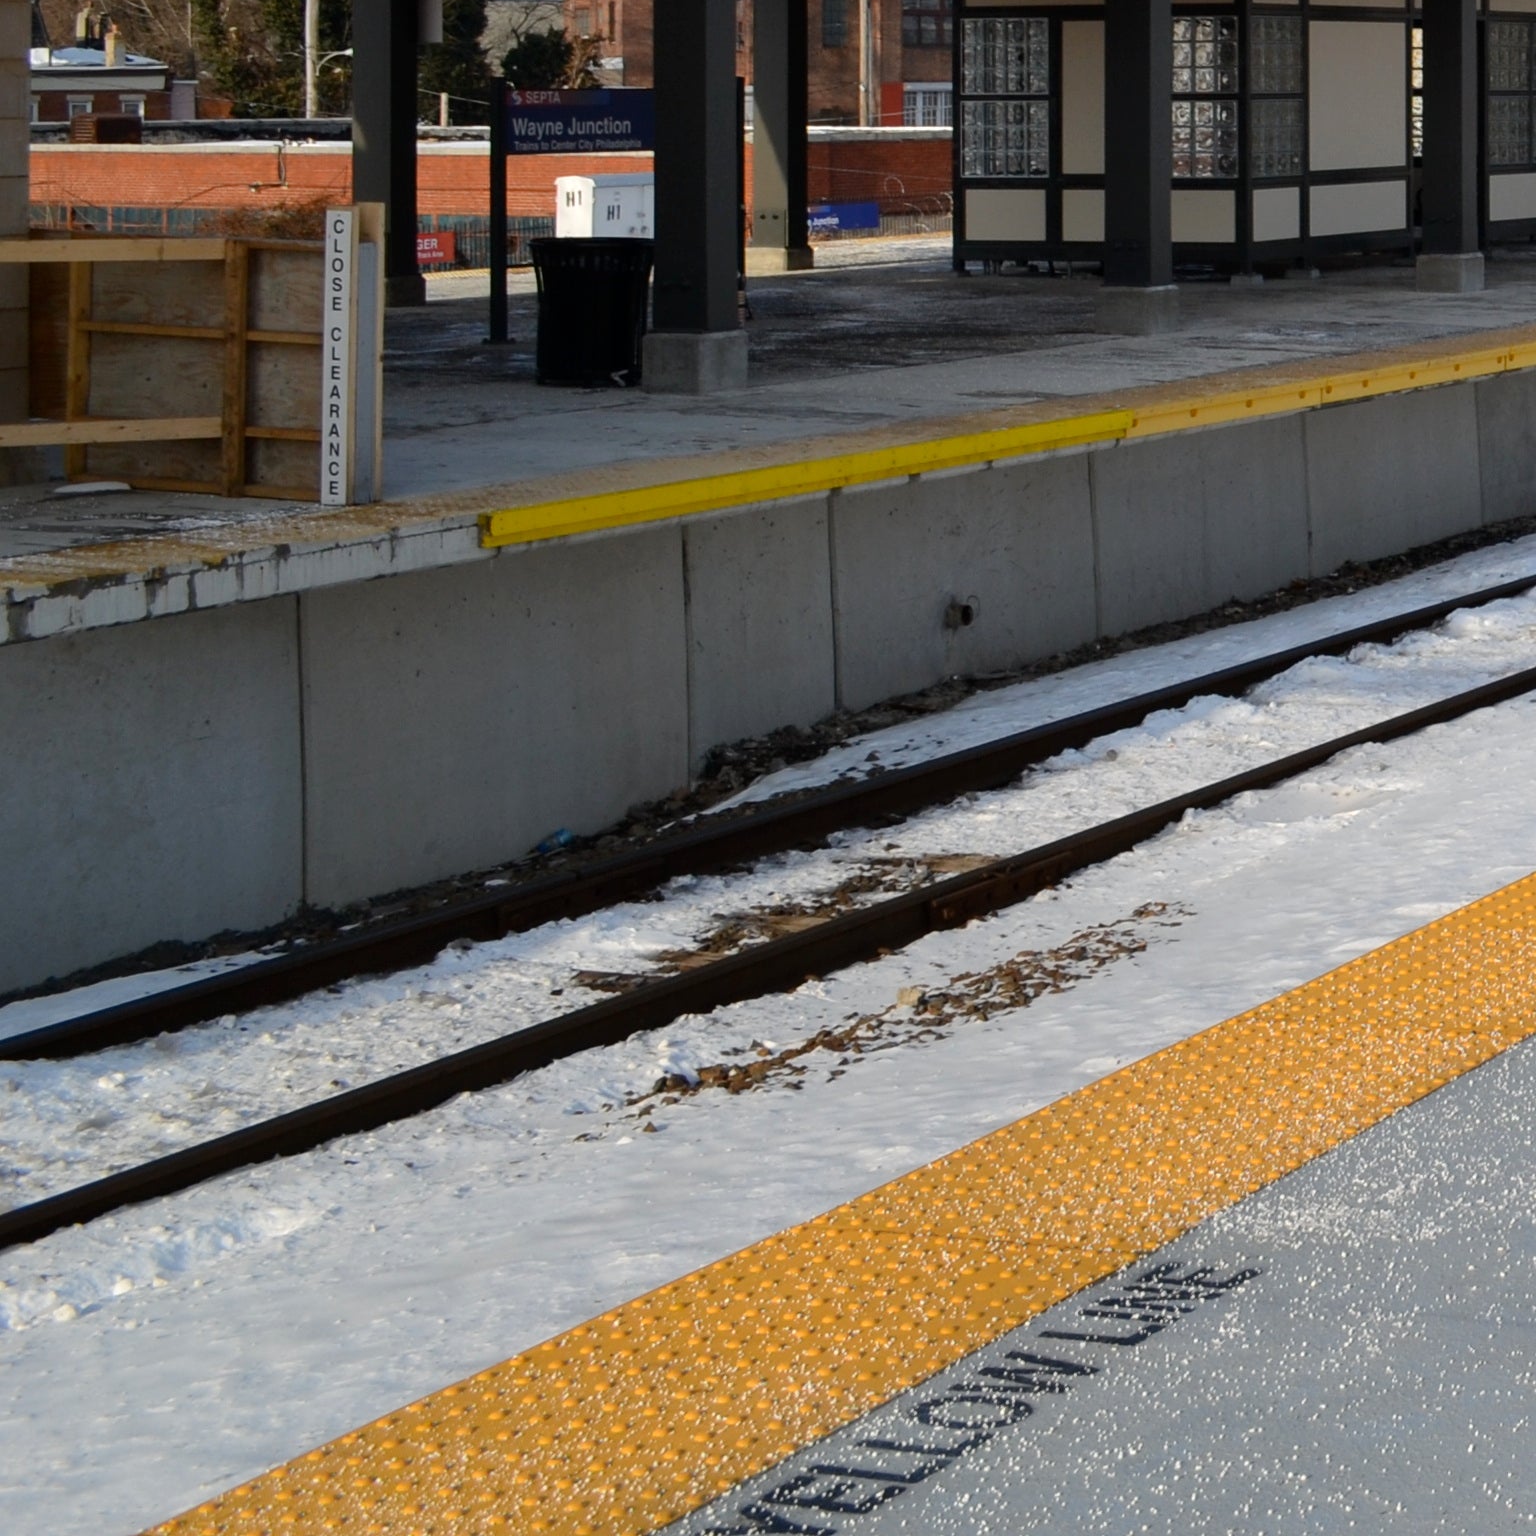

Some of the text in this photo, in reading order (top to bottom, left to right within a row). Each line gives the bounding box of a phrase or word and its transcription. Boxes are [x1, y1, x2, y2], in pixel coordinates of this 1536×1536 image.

[526, 90, 560, 104] SEPTA
[512, 116, 631, 140] Wayne Junction
[514, 141, 539, 150] Trains
[551, 140, 577, 150] Center
[580, 139, 594, 150] City
[595, 138, 642, 149] Philadelphia
[328, 219, 345, 495] CLOSE CLEARANCE
[1038, 1261, 1264, 1346] LINE
